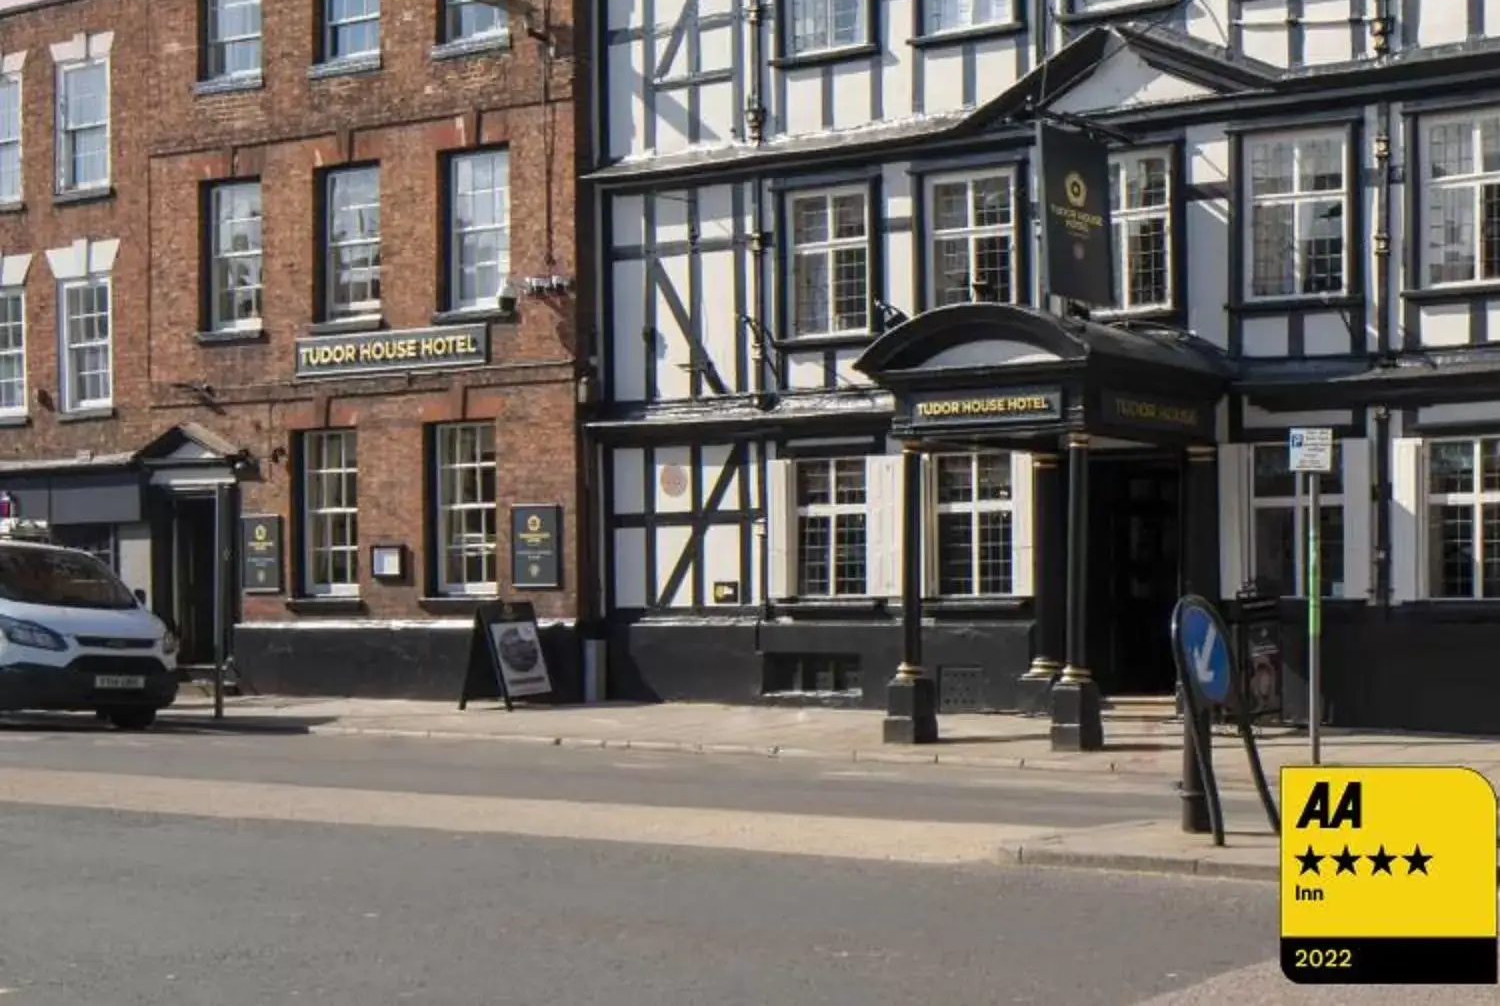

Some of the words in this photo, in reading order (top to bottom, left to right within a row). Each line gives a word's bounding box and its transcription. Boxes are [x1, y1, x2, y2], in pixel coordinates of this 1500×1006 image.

[299, 346, 356, 365] TUDOR
[360, 339, 417, 360] HOUSE
[421, 334, 477, 355] HOTEL
[916, 402, 959, 415] TUDOR
[962, 398, 1005, 413] HOUSE
[1007, 396, 1049, 410] HOTEL
